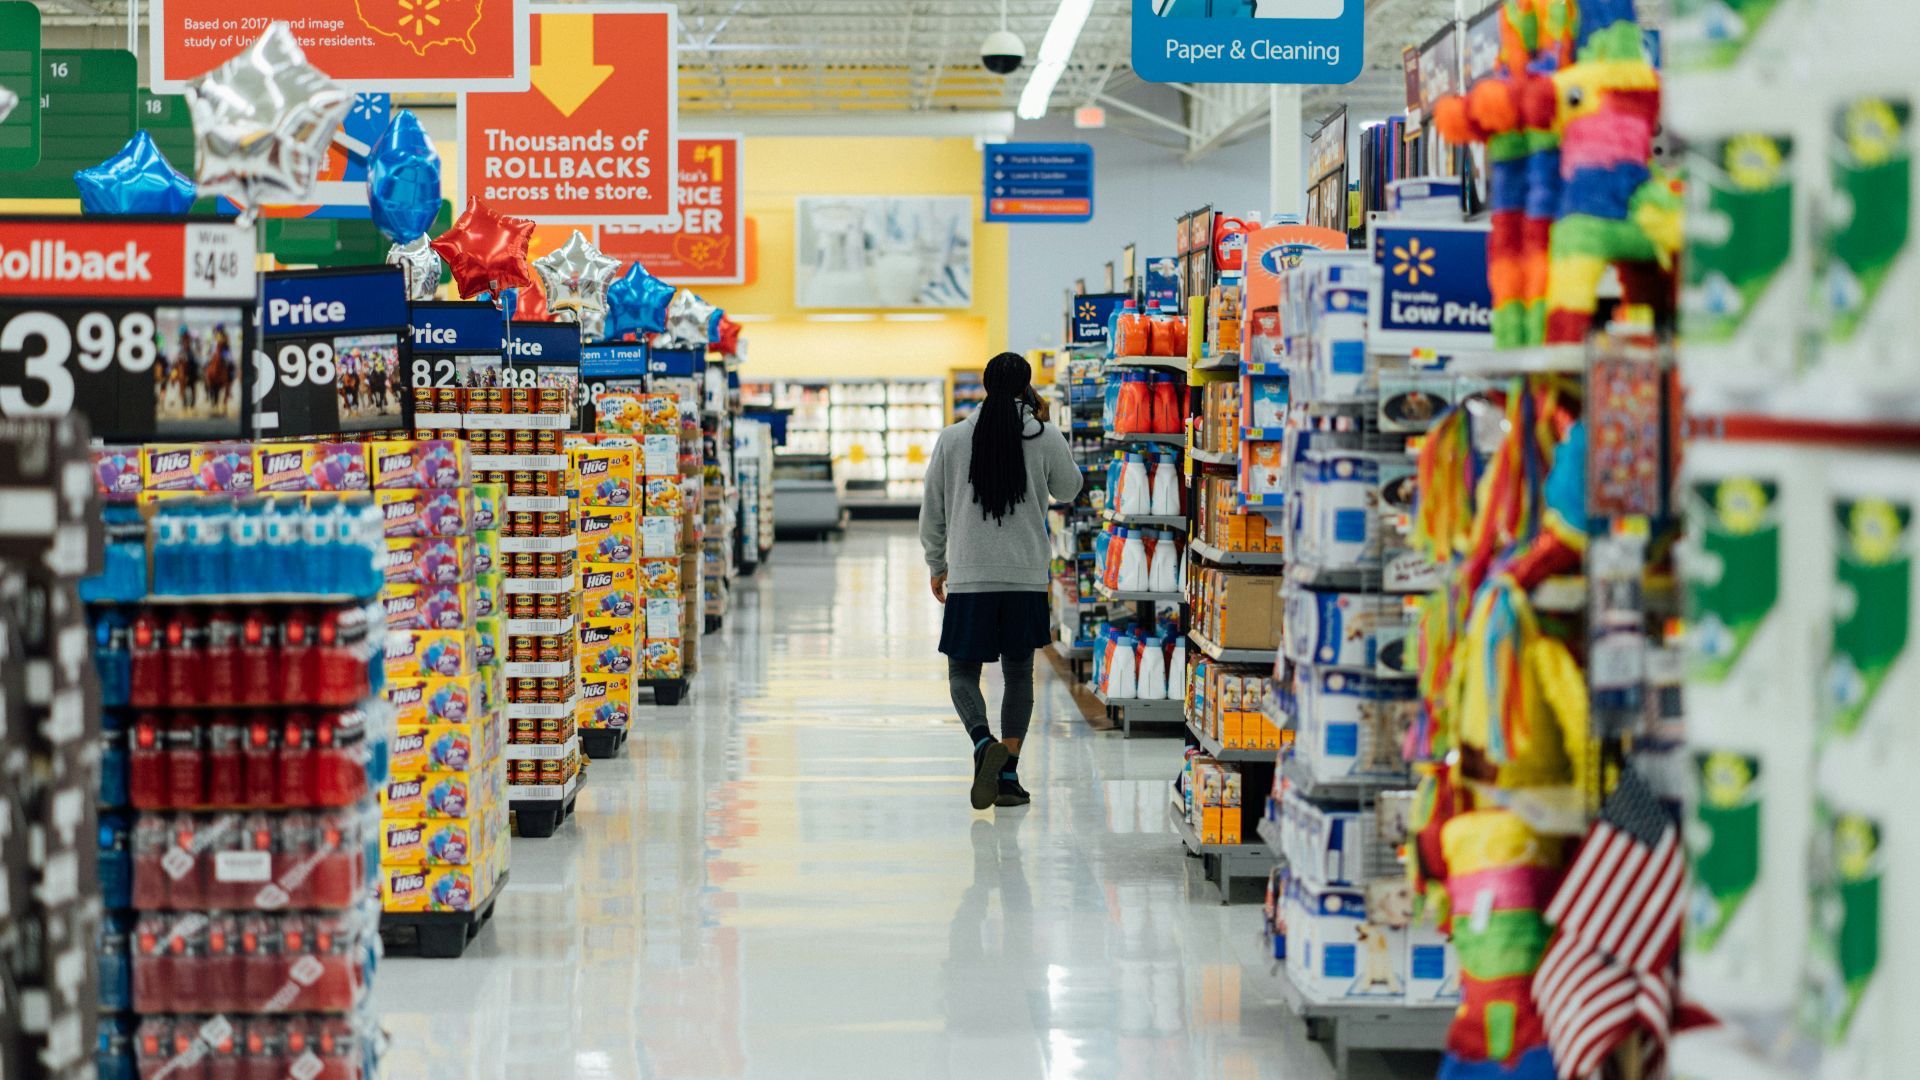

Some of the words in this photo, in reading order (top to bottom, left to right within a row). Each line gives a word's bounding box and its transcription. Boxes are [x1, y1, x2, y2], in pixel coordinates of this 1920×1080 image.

[184, 18, 219, 29] Based
[224, 20, 238, 29] on
[241, 18, 267, 29] 2017
[308, 19, 344, 33] image
[184, 36, 216, 49] study
[220, 36, 232, 46] of
[319, 36, 376, 46] residents.
[1166, 39, 1225, 64] Paper
[1229, 39, 1246, 60] &
[1250, 39, 1340, 66] Cleaning
[51, 63, 68, 77] 16
[146, 100, 161, 114] 18
[485, 129, 613, 152] Thousands
[621, 129, 649, 151] of
[485, 157, 651, 178] ROLLBACKS
[694, 144, 723, 182] #1
[485, 185, 547, 200] across
[555, 182, 588, 200] the
[594, 183, 652, 200] store.
[269, 296, 346, 326] Price
[1391, 303, 1441, 323] Low
[1080, 327, 1101, 337] Low
[617, 349, 641, 358] meal
[412, 359, 455, 388] 82
[156, 455, 189, 473] HUG
[267, 455, 300, 474] HUG
[383, 456, 411, 472] HUG
[582, 462, 607, 475] HUG
[387, 503, 415, 519] HUG
[586, 575, 611, 588] HUG
[583, 685, 605, 698] HUG
[392, 783, 420, 799] HUG
[391, 831, 420, 847] HUG
[395, 876, 423, 892] HUG
